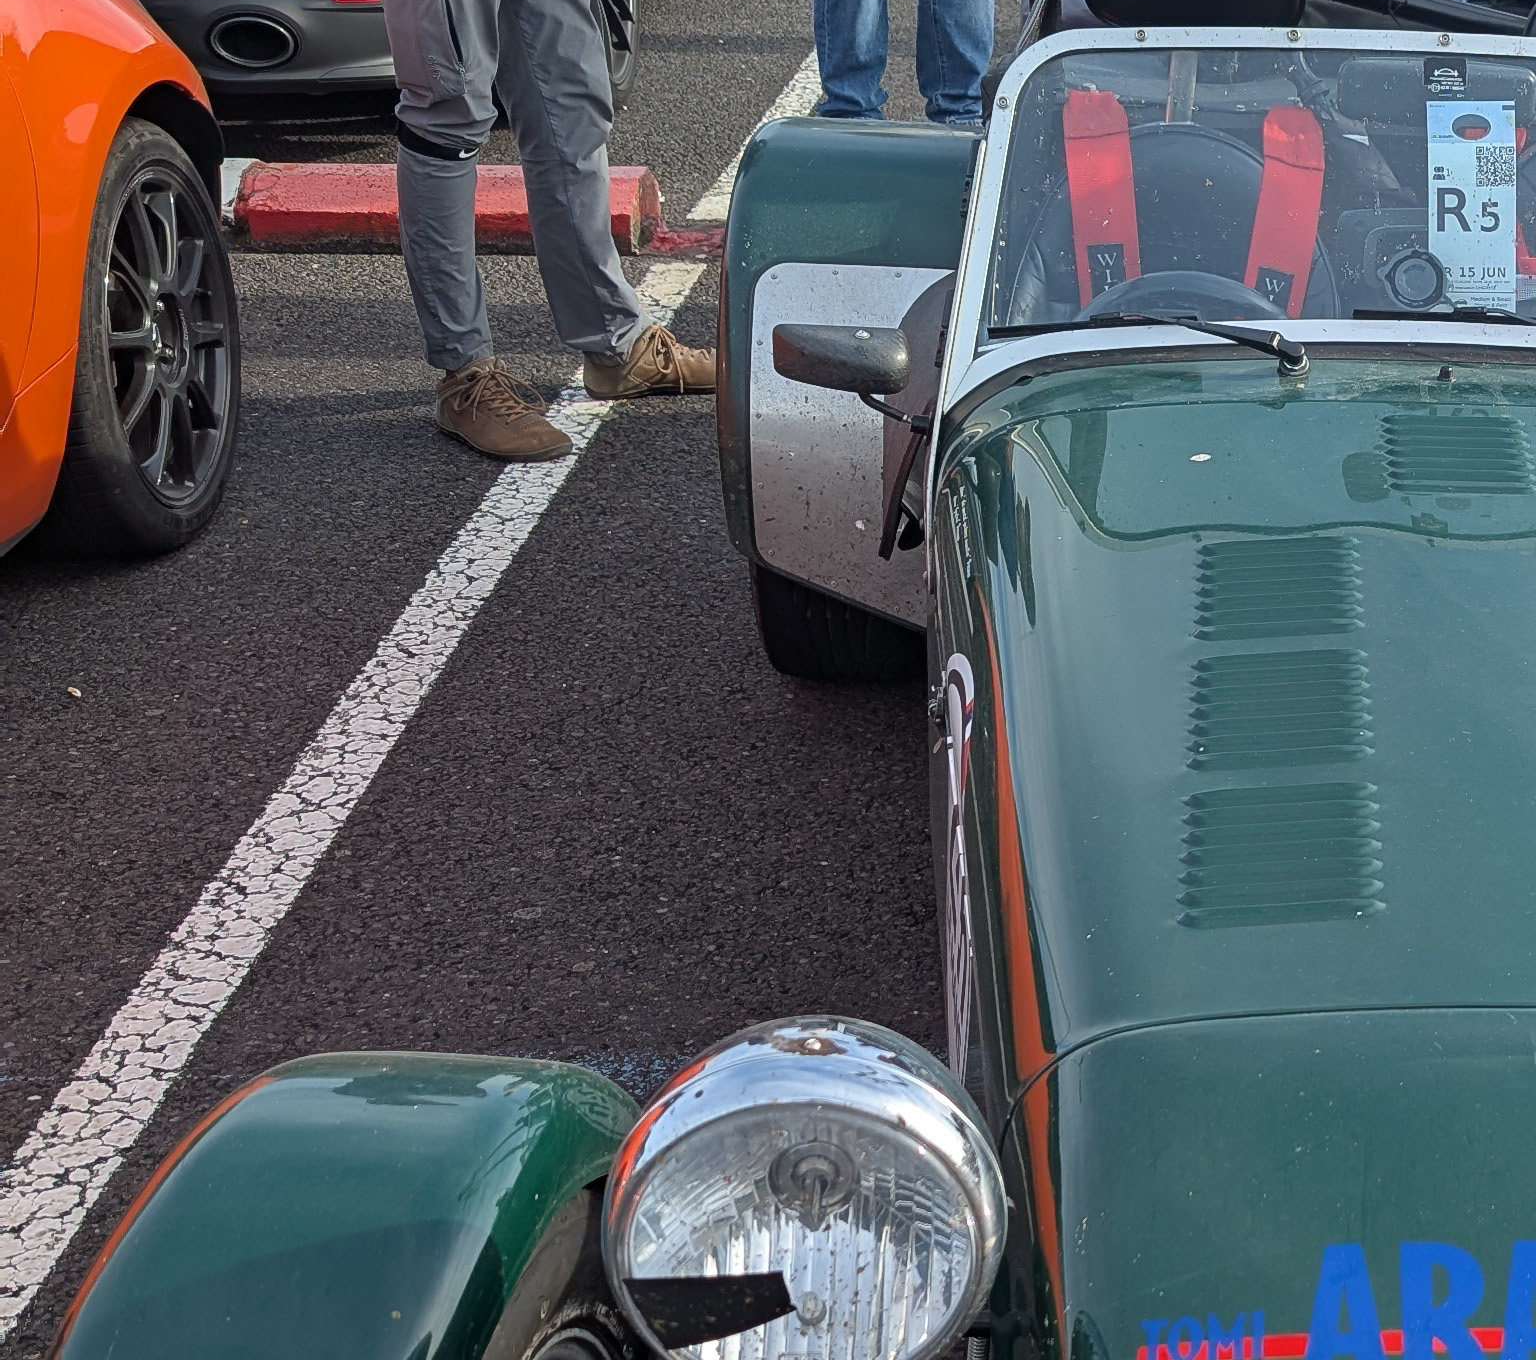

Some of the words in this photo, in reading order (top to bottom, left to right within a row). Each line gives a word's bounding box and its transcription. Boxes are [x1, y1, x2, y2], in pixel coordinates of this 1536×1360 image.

[1437, 187, 1473, 233] R
[1480, 201, 1501, 233] 5
[1459, 266, 1476, 278] 15
[1480, 266, 1506, 281] JUN
